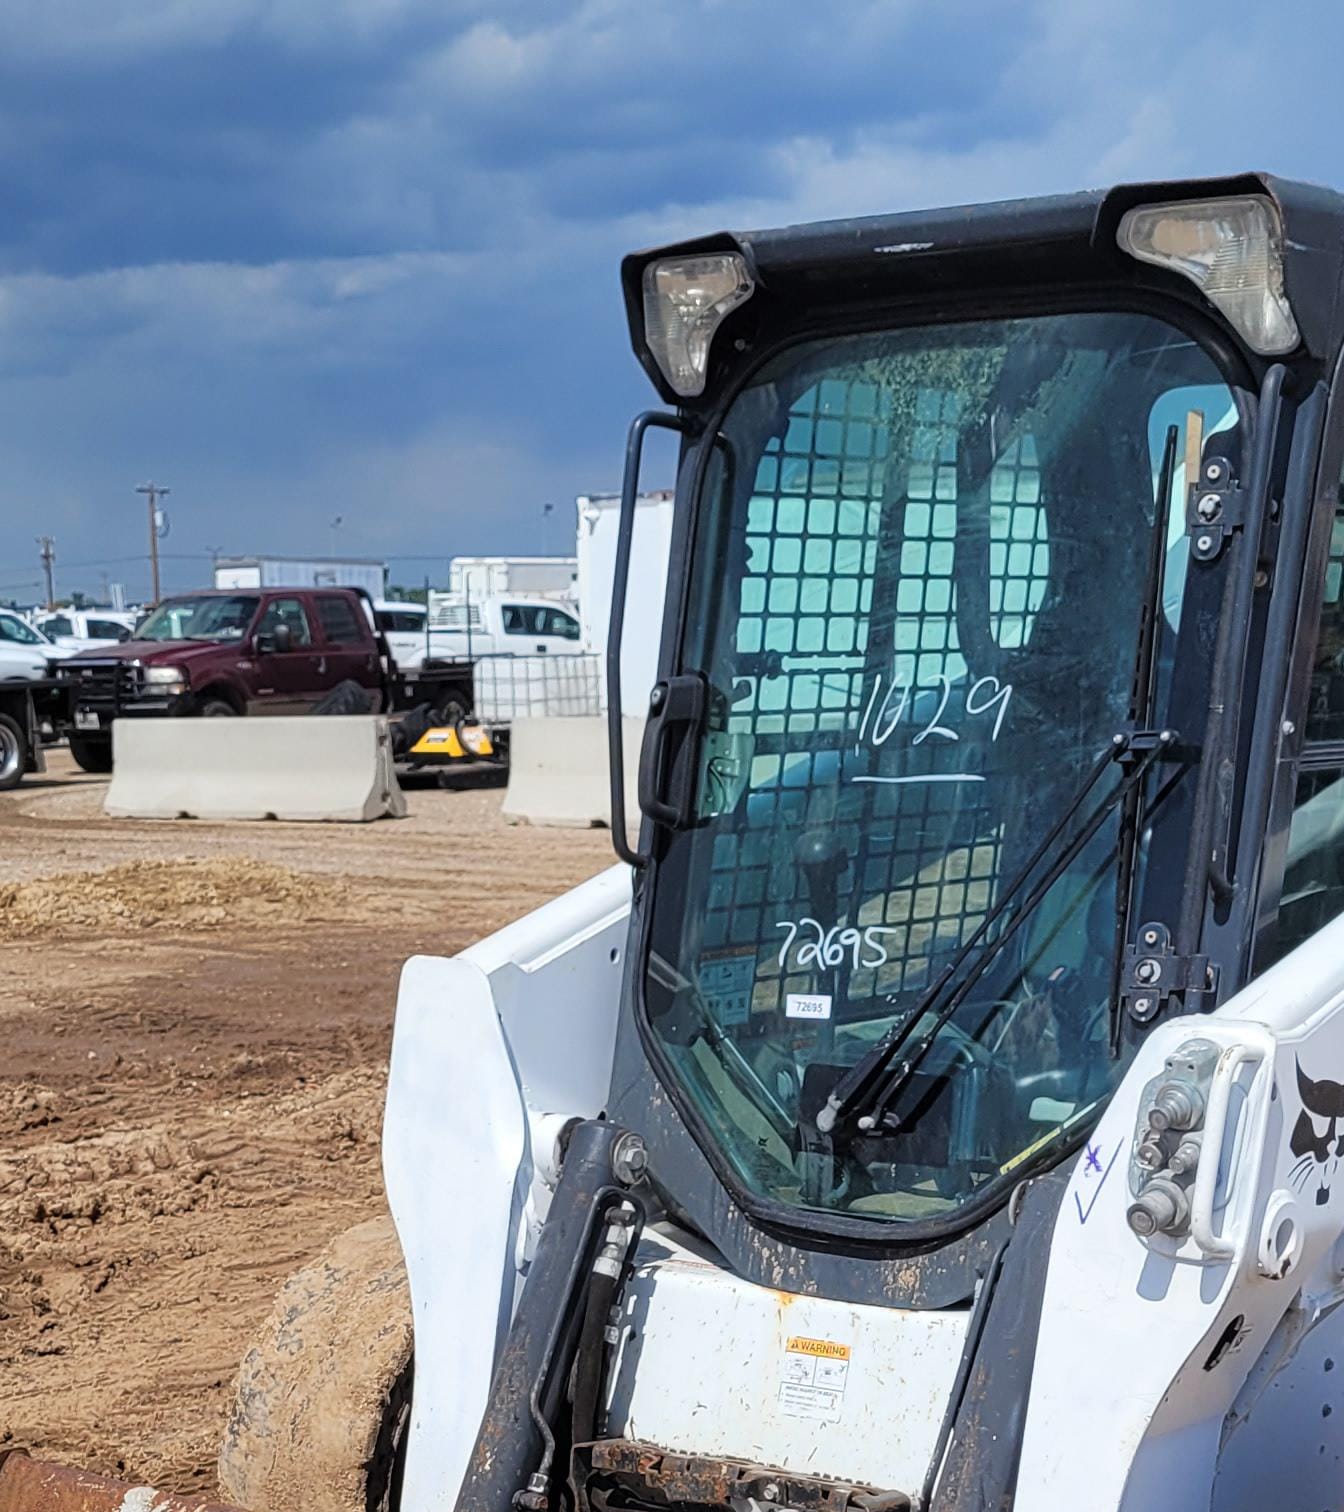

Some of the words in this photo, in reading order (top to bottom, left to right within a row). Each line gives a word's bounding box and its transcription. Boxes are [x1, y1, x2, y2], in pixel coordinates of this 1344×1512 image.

[858, 672, 1013, 746] 1029
[775, 917, 897, 971] 72695
[801, 1341, 846, 1357] WARNING
